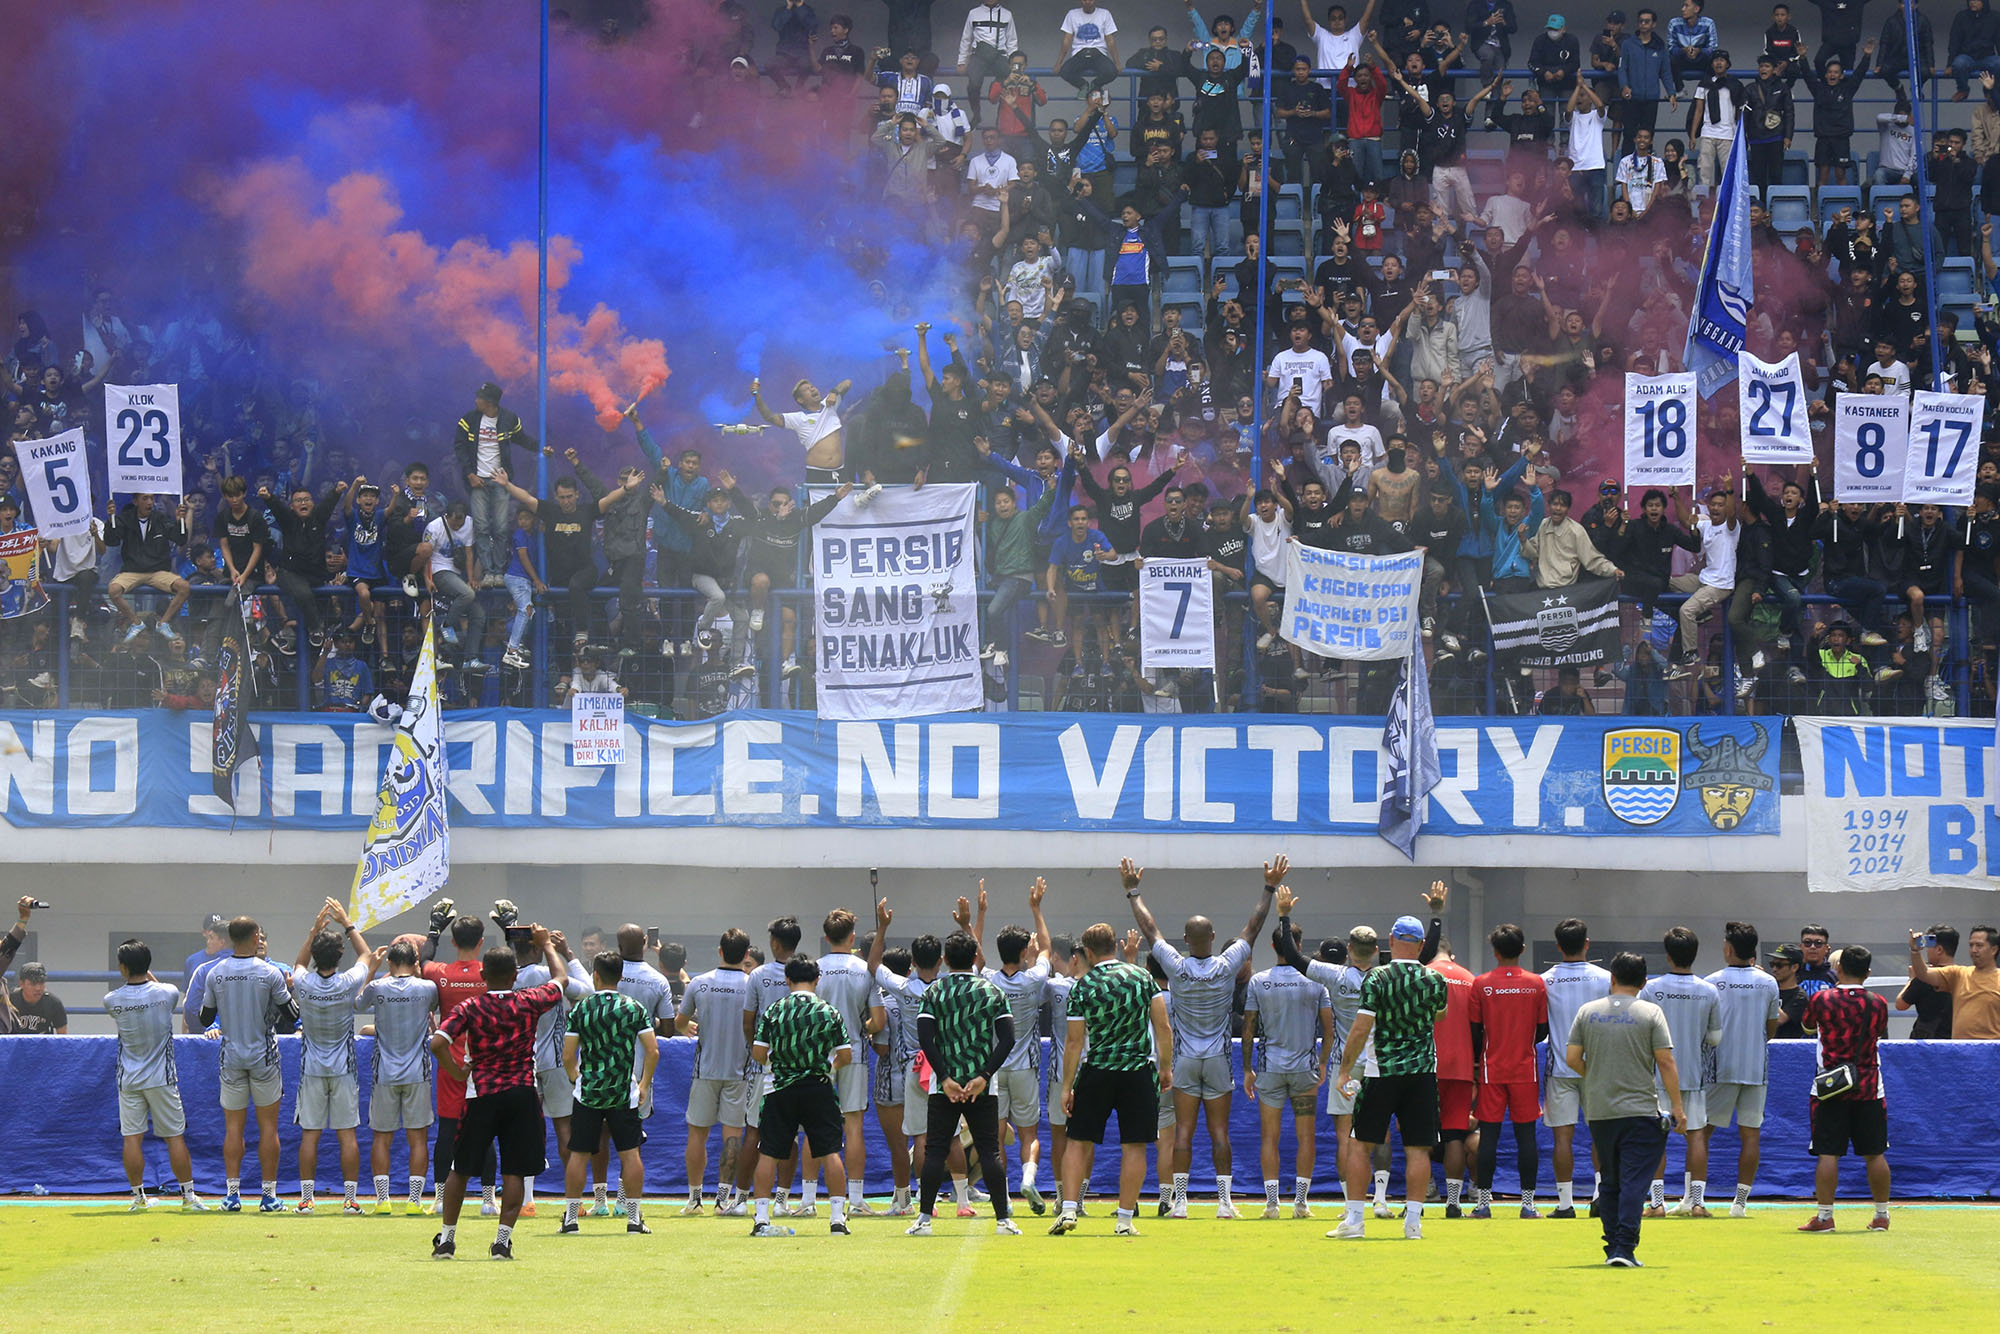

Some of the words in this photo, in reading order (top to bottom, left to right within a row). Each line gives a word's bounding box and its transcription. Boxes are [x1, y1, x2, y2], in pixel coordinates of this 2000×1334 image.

[128, 394, 155, 406] KLOK
[1636, 385, 1664, 395] ADAM
[1666, 384, 1687, 394] ALIS
[1748, 379, 1796, 437] 27
[1845, 405, 1900, 418] KASTANEER
[1922, 404, 1945, 413] MATEO
[1945, 405, 1975, 416] KOCIJAN
[116, 408, 171, 468] 23
[1635, 399, 1687, 459] 18
[30, 440, 77, 460] KAKANG
[1855, 422, 1886, 479] 8
[1920, 418, 1973, 479] 17
[44, 457, 79, 514] 5
[1916, 485, 1931, 493] VIKING
[821, 529, 964, 578] PERSIB
[1300, 548, 1345, 568] SAUR
[1348, 557, 1366, 571] SI
[1150, 566, 1202, 578] BECKHAM
[1303, 573, 1369, 598] KAGOK
[1372, 583, 1412, 599] EDAN
[823, 584, 925, 627] SANG
[1163, 582, 1192, 640] 7
[1377, 606, 1407, 624] DEI
[1541, 610, 1574, 621] PERSIB
[1293, 616, 1382, 650] PERSIB
[821, 623, 974, 673] PENAKLUK
[1554, 648, 1604, 666] BANDUNG
[577, 696, 623, 711] IMBANG
[579, 719, 618, 731] KALAH
[577, 751, 594, 760] DIRI
[597, 748, 625, 763] KAMI
[1611, 736, 1673, 755] PERSIB
[0, 717, 139, 816] NO
[836, 721, 1000, 819] NO
[1843, 809, 1909, 831] 1994
[1848, 833, 1906, 853] 2014
[1847, 855, 1904, 876] 2024
